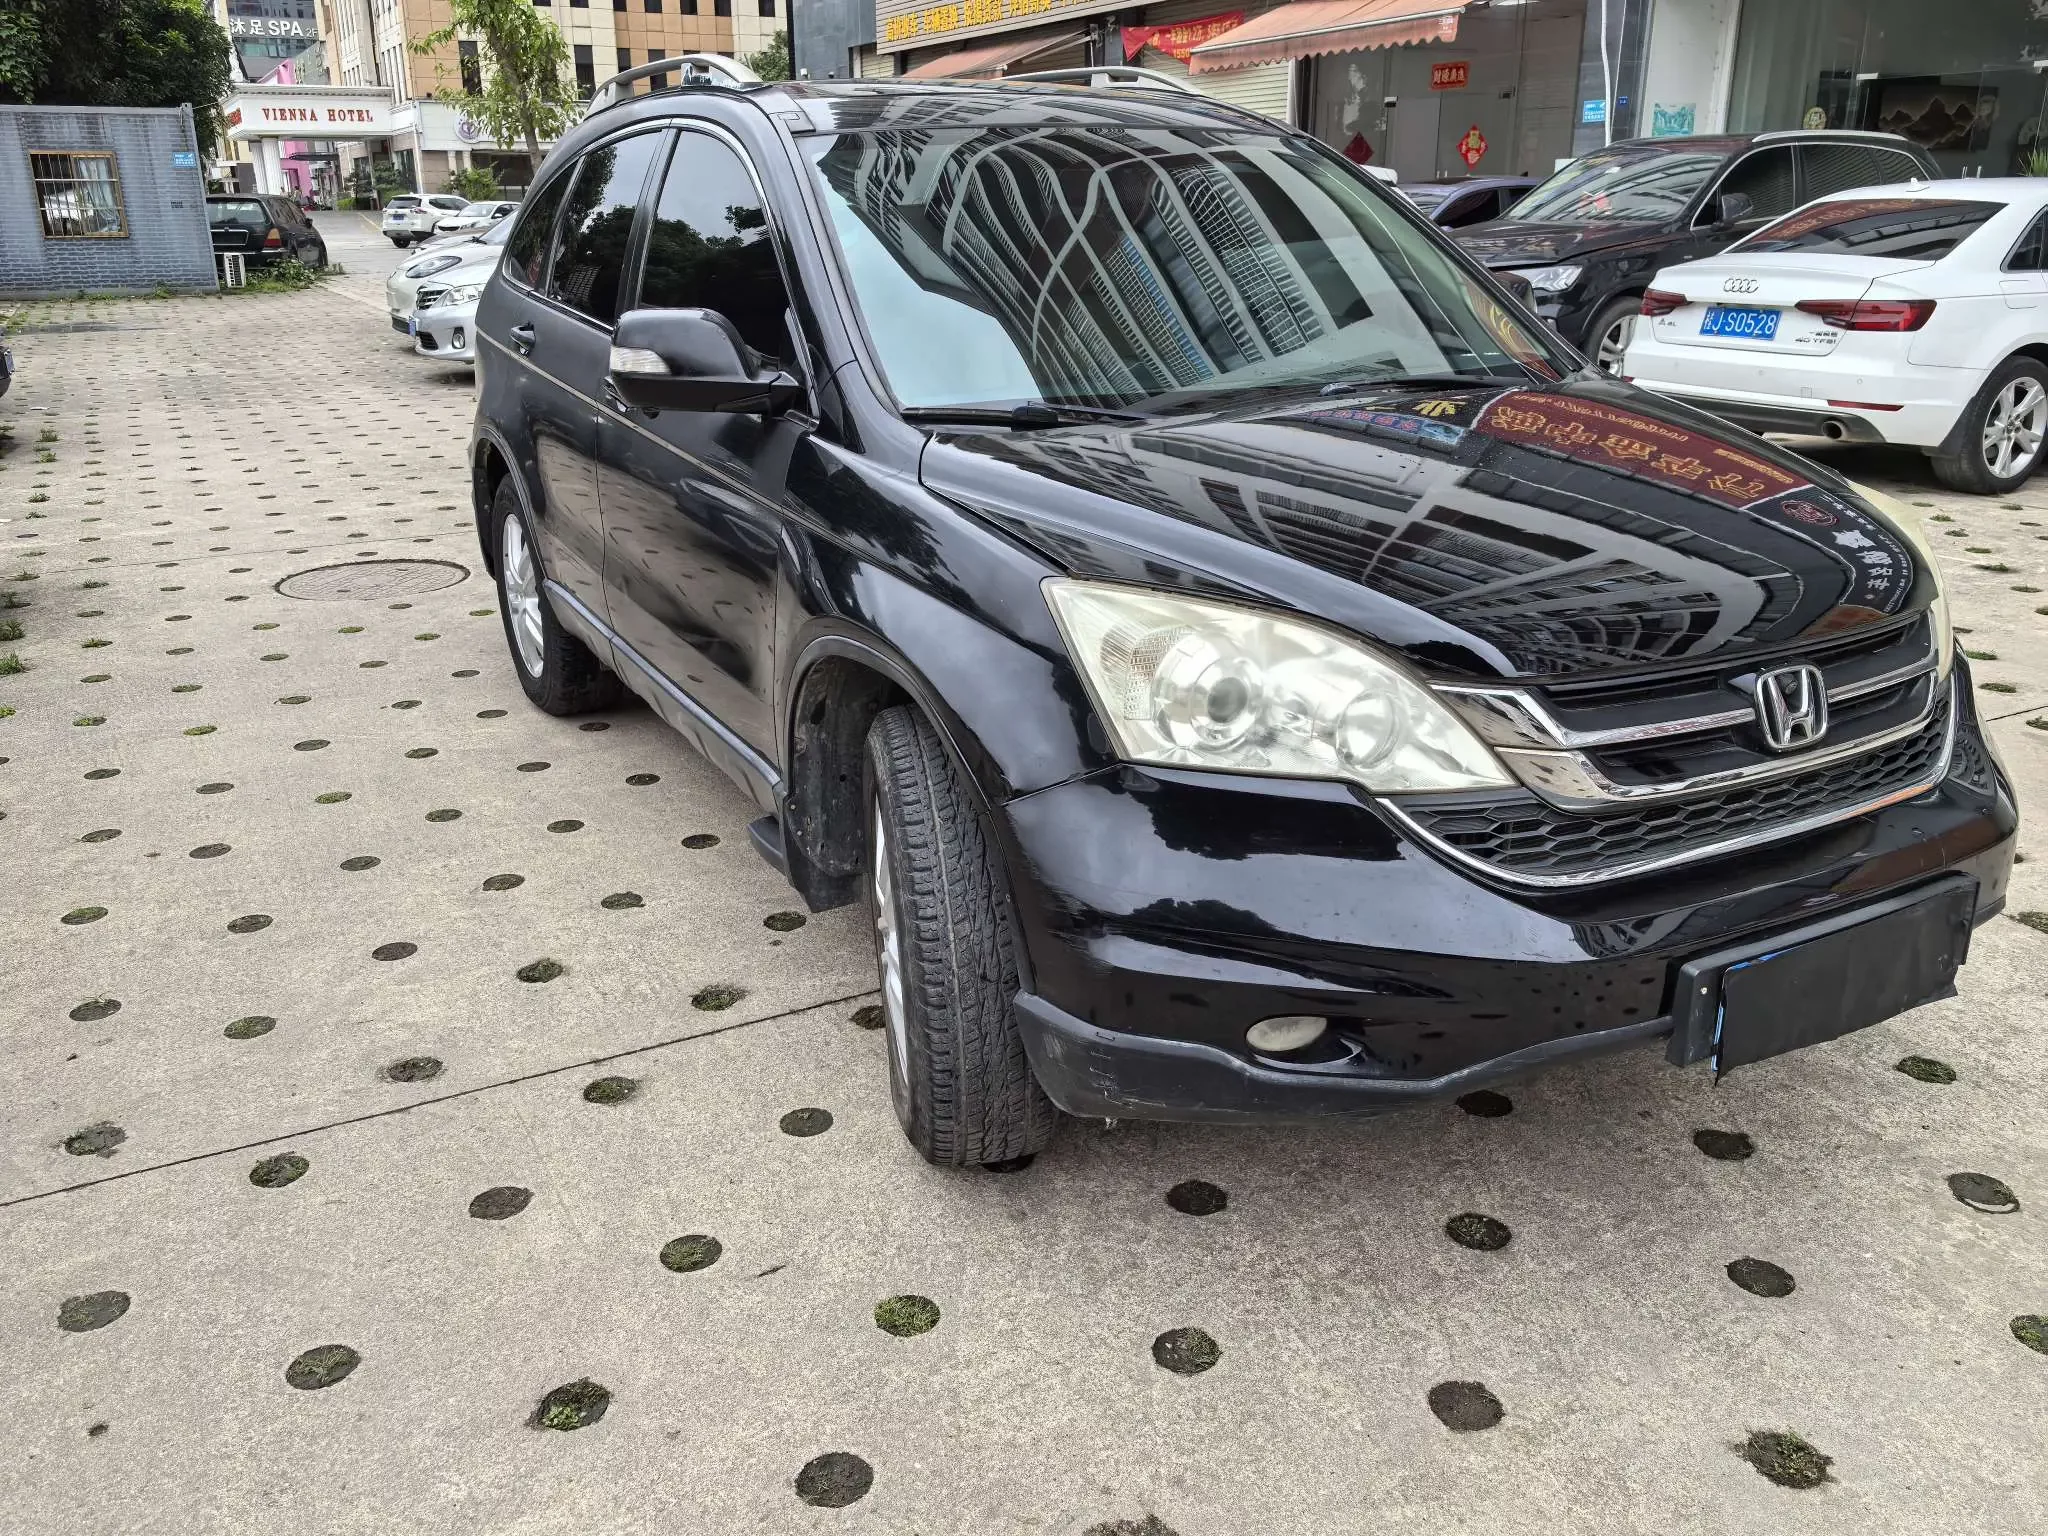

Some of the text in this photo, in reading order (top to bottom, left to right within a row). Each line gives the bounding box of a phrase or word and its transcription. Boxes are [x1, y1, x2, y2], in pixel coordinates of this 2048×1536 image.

[268, 20, 304, 37] SPA
[262, 108, 374, 122] VIENNA HOTEL
